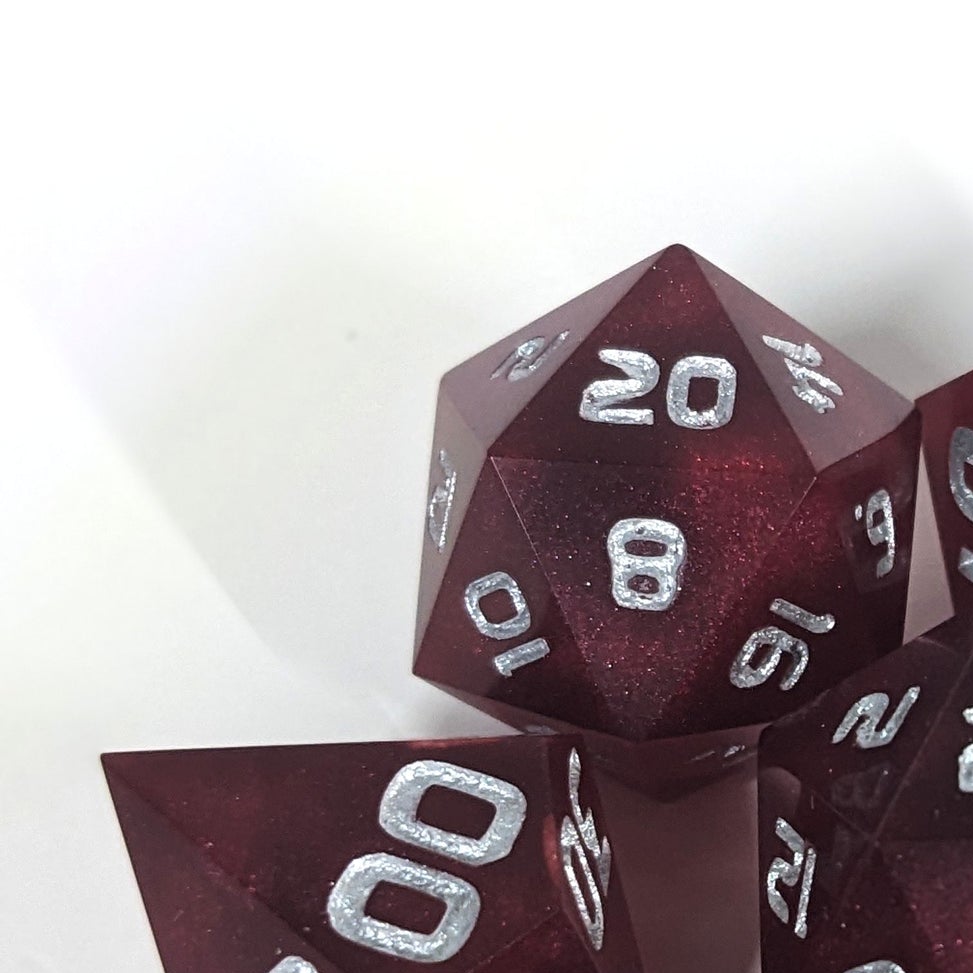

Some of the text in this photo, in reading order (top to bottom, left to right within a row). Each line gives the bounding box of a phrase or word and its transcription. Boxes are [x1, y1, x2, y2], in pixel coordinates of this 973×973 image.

[579, 348, 737, 430] 20
[762, 334, 844, 414] 14
[607, 517, 687, 611] 8
[464, 571, 550, 677] 10
[729, 598, 836, 692] 16
[832, 686, 921, 749] 2
[327, 760, 527, 963] 00
